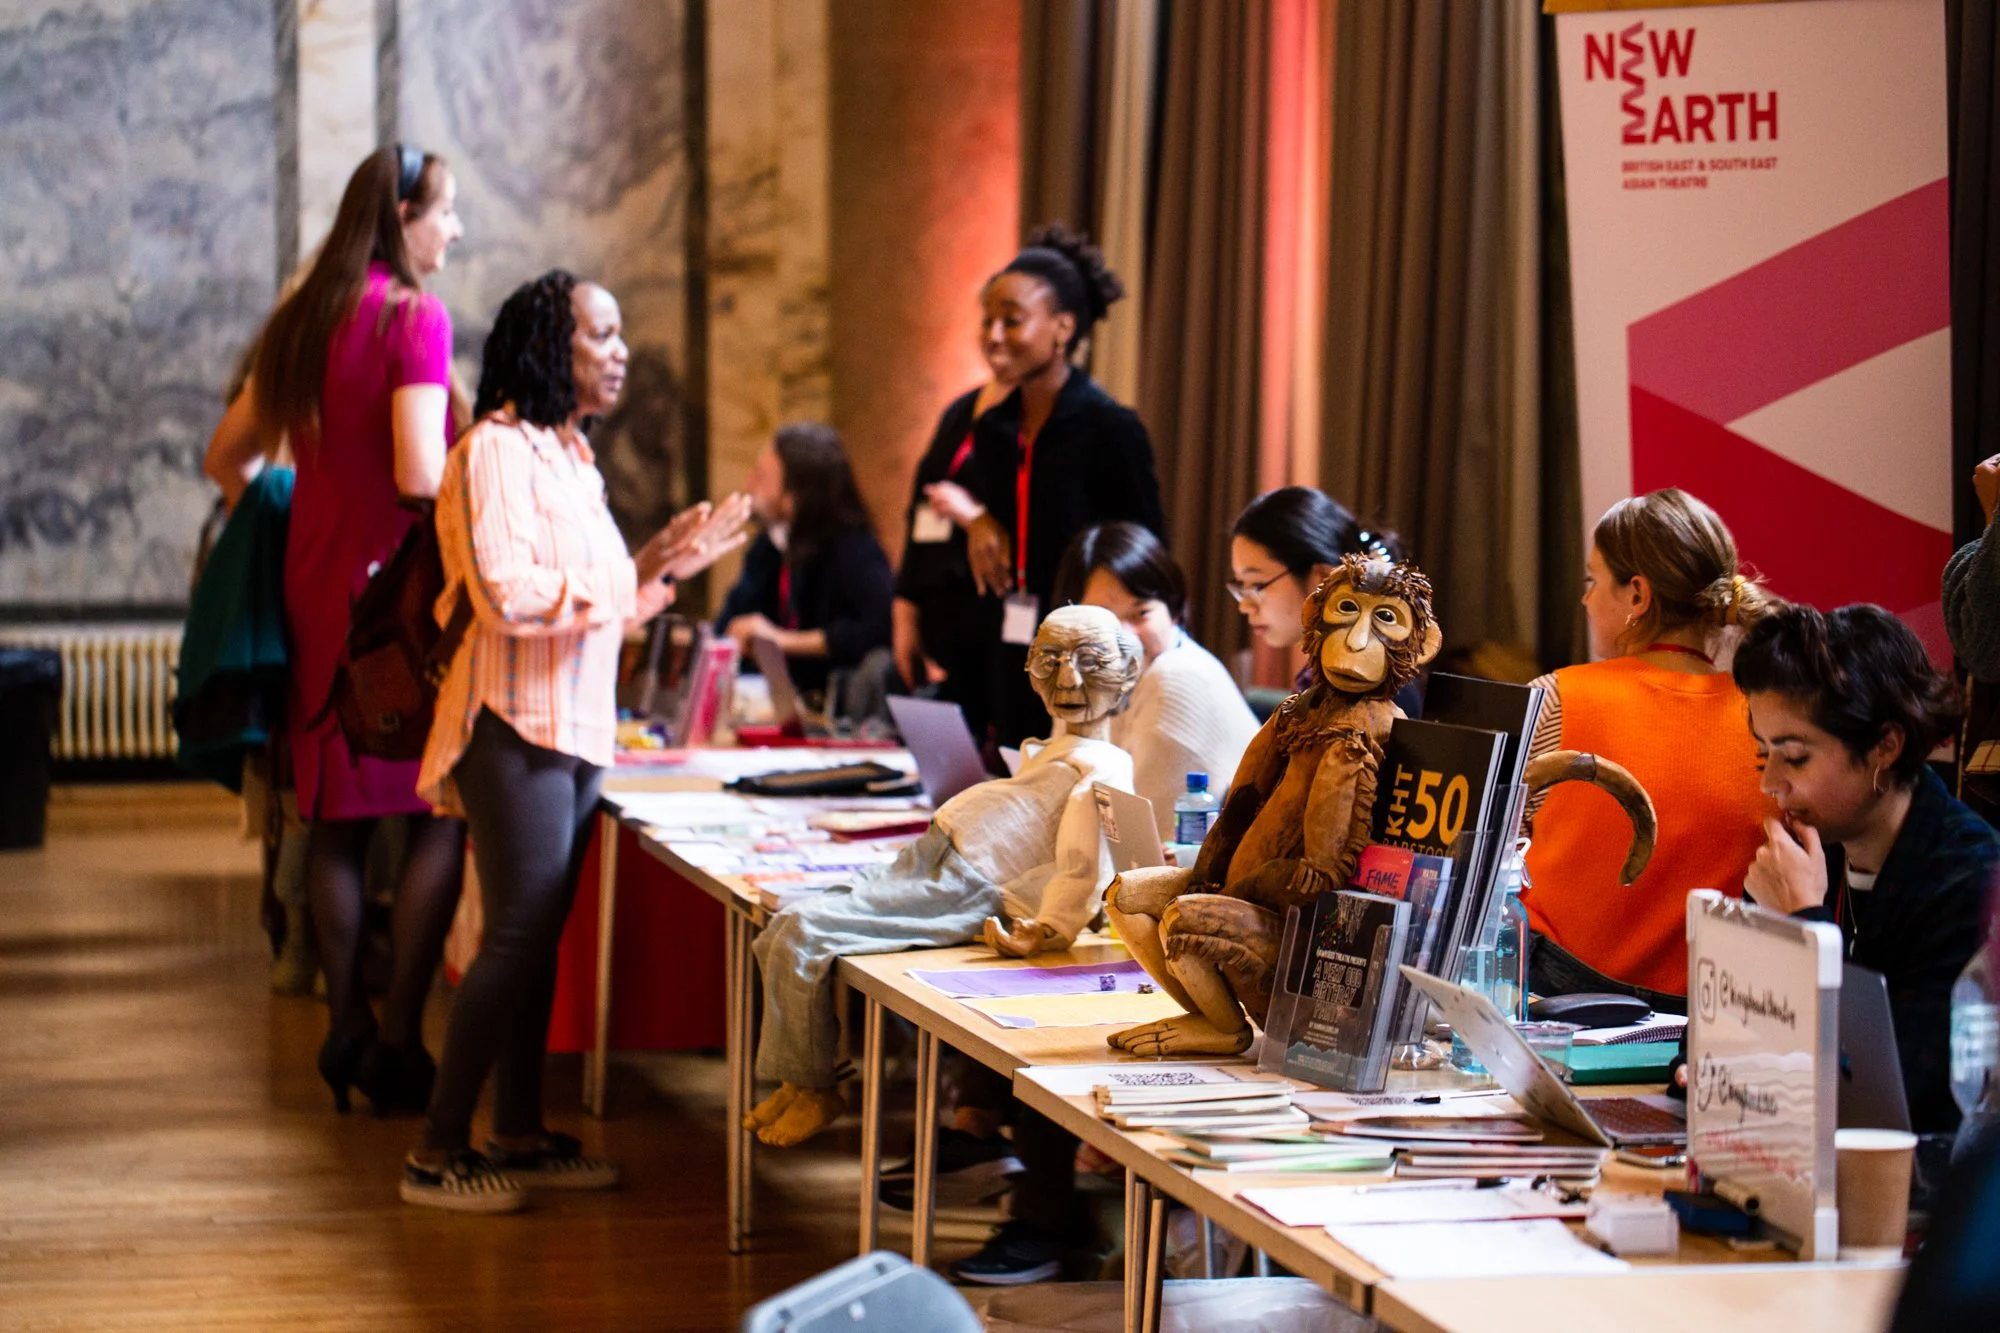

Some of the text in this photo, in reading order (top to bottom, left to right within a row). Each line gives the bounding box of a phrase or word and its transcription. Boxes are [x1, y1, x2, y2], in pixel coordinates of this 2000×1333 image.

[1585, 21, 1696, 81] NEW
[1621, 91, 1779, 145] EARTH
[1622, 156, 1778, 173] BRITISH EAST & SOUTH EAST
[1622, 176, 1708, 190] ASIAN THEATRE
[1385, 764, 1469, 845] KHT 50
[1366, 868, 1402, 889] FAME
[1322, 961, 1347, 984] VERY
